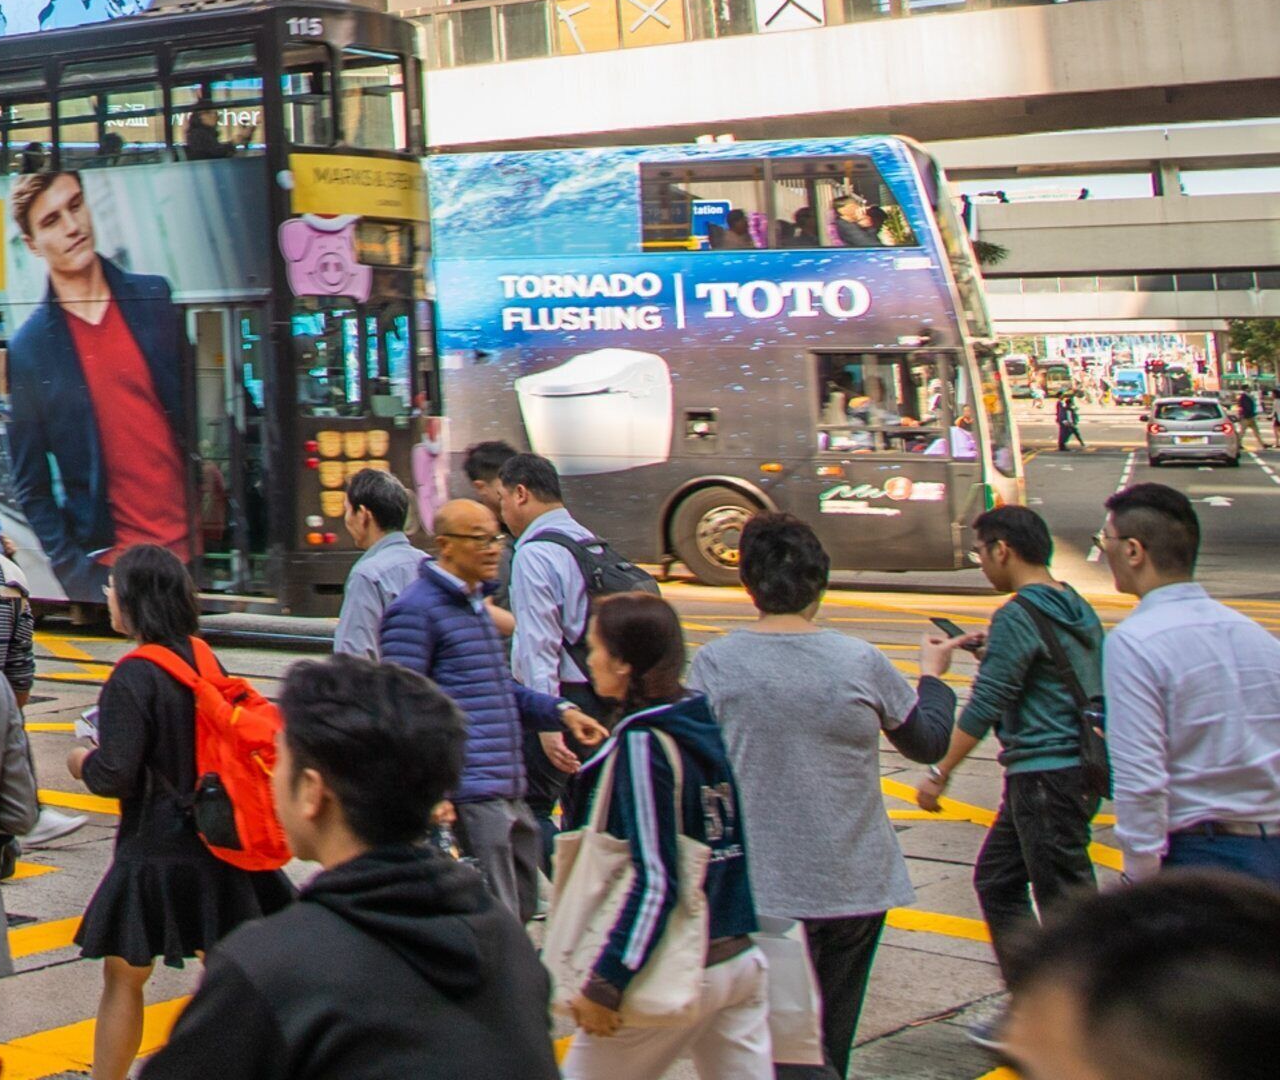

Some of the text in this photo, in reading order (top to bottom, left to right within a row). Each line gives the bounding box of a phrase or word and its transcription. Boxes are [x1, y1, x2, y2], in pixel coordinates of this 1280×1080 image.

[286, 17, 324, 36] 115
[497, 271, 663, 300] TORNADO
[694, 278, 873, 319] TOTO
[501, 304, 663, 332] FLUSHING
